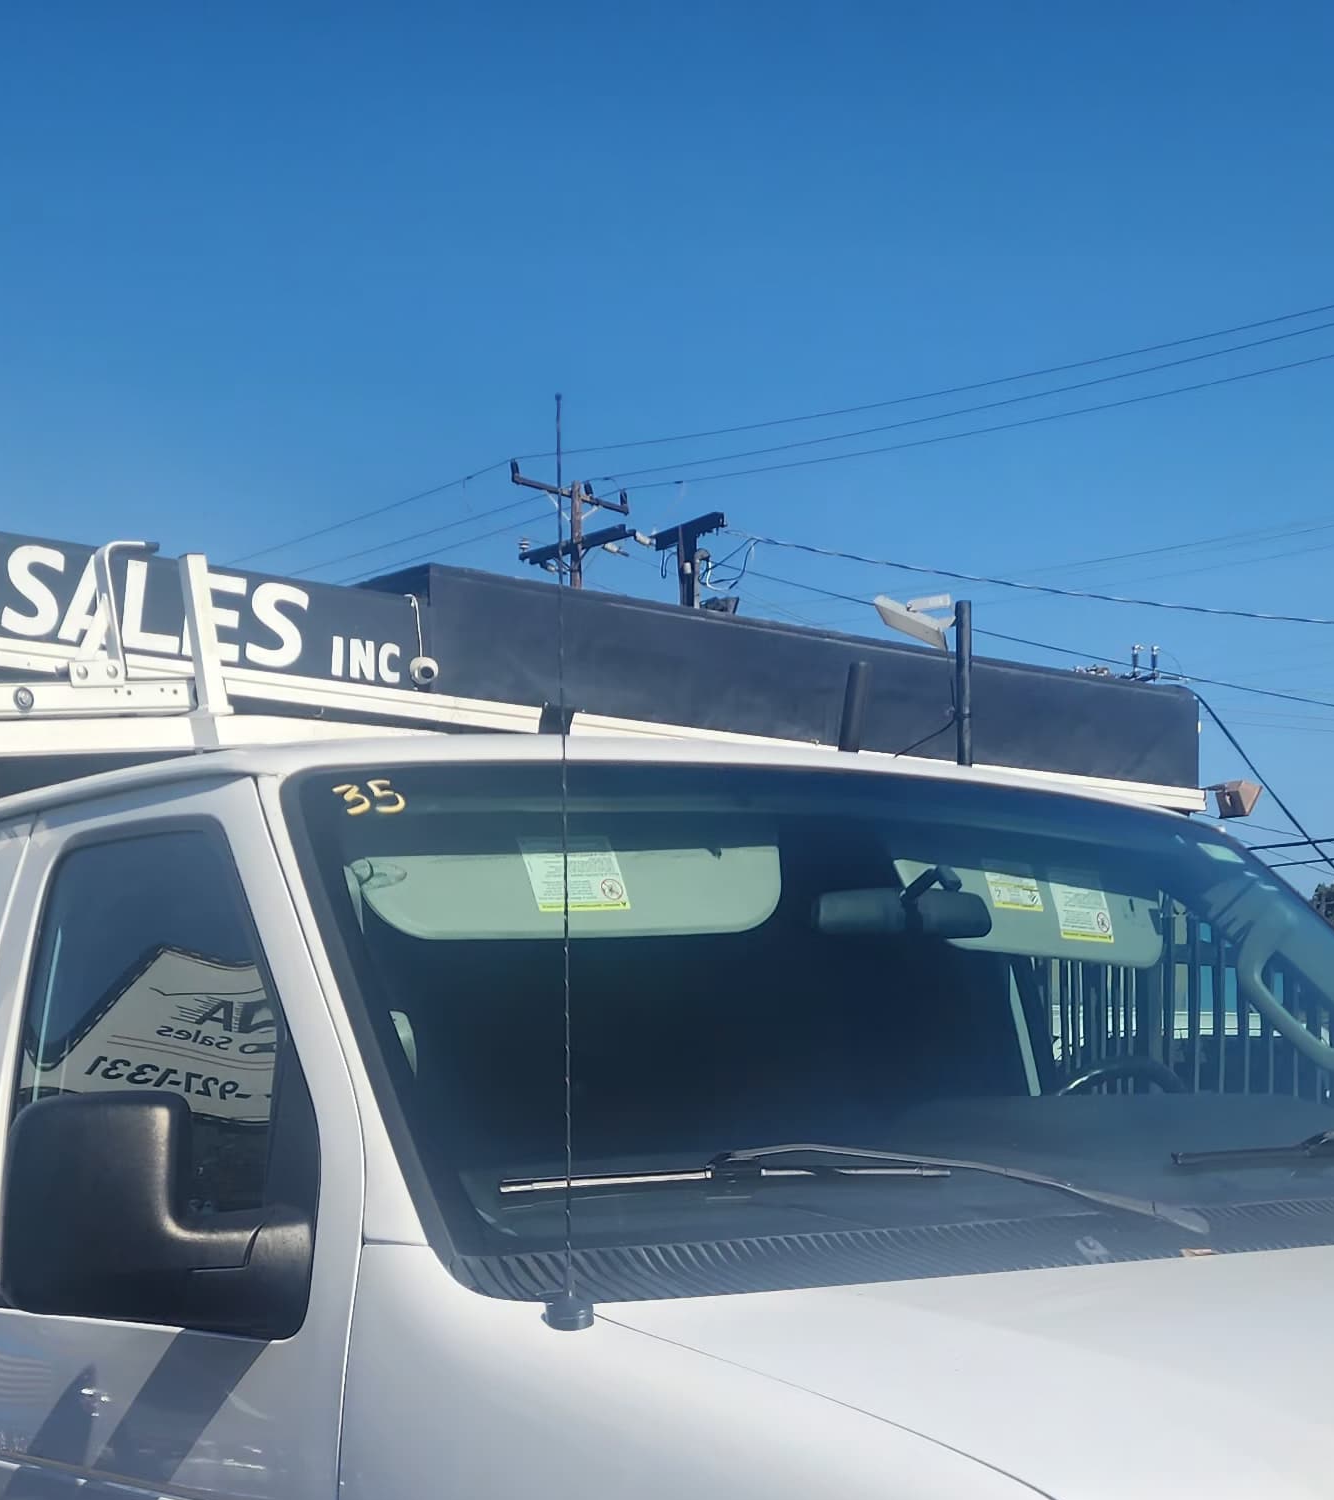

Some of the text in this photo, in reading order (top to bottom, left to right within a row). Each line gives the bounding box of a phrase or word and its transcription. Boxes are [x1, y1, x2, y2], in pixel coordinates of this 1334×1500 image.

[0, 545, 310, 667] SALES
[330, 635, 401, 683] INC
[331, 779, 406, 816] 35
